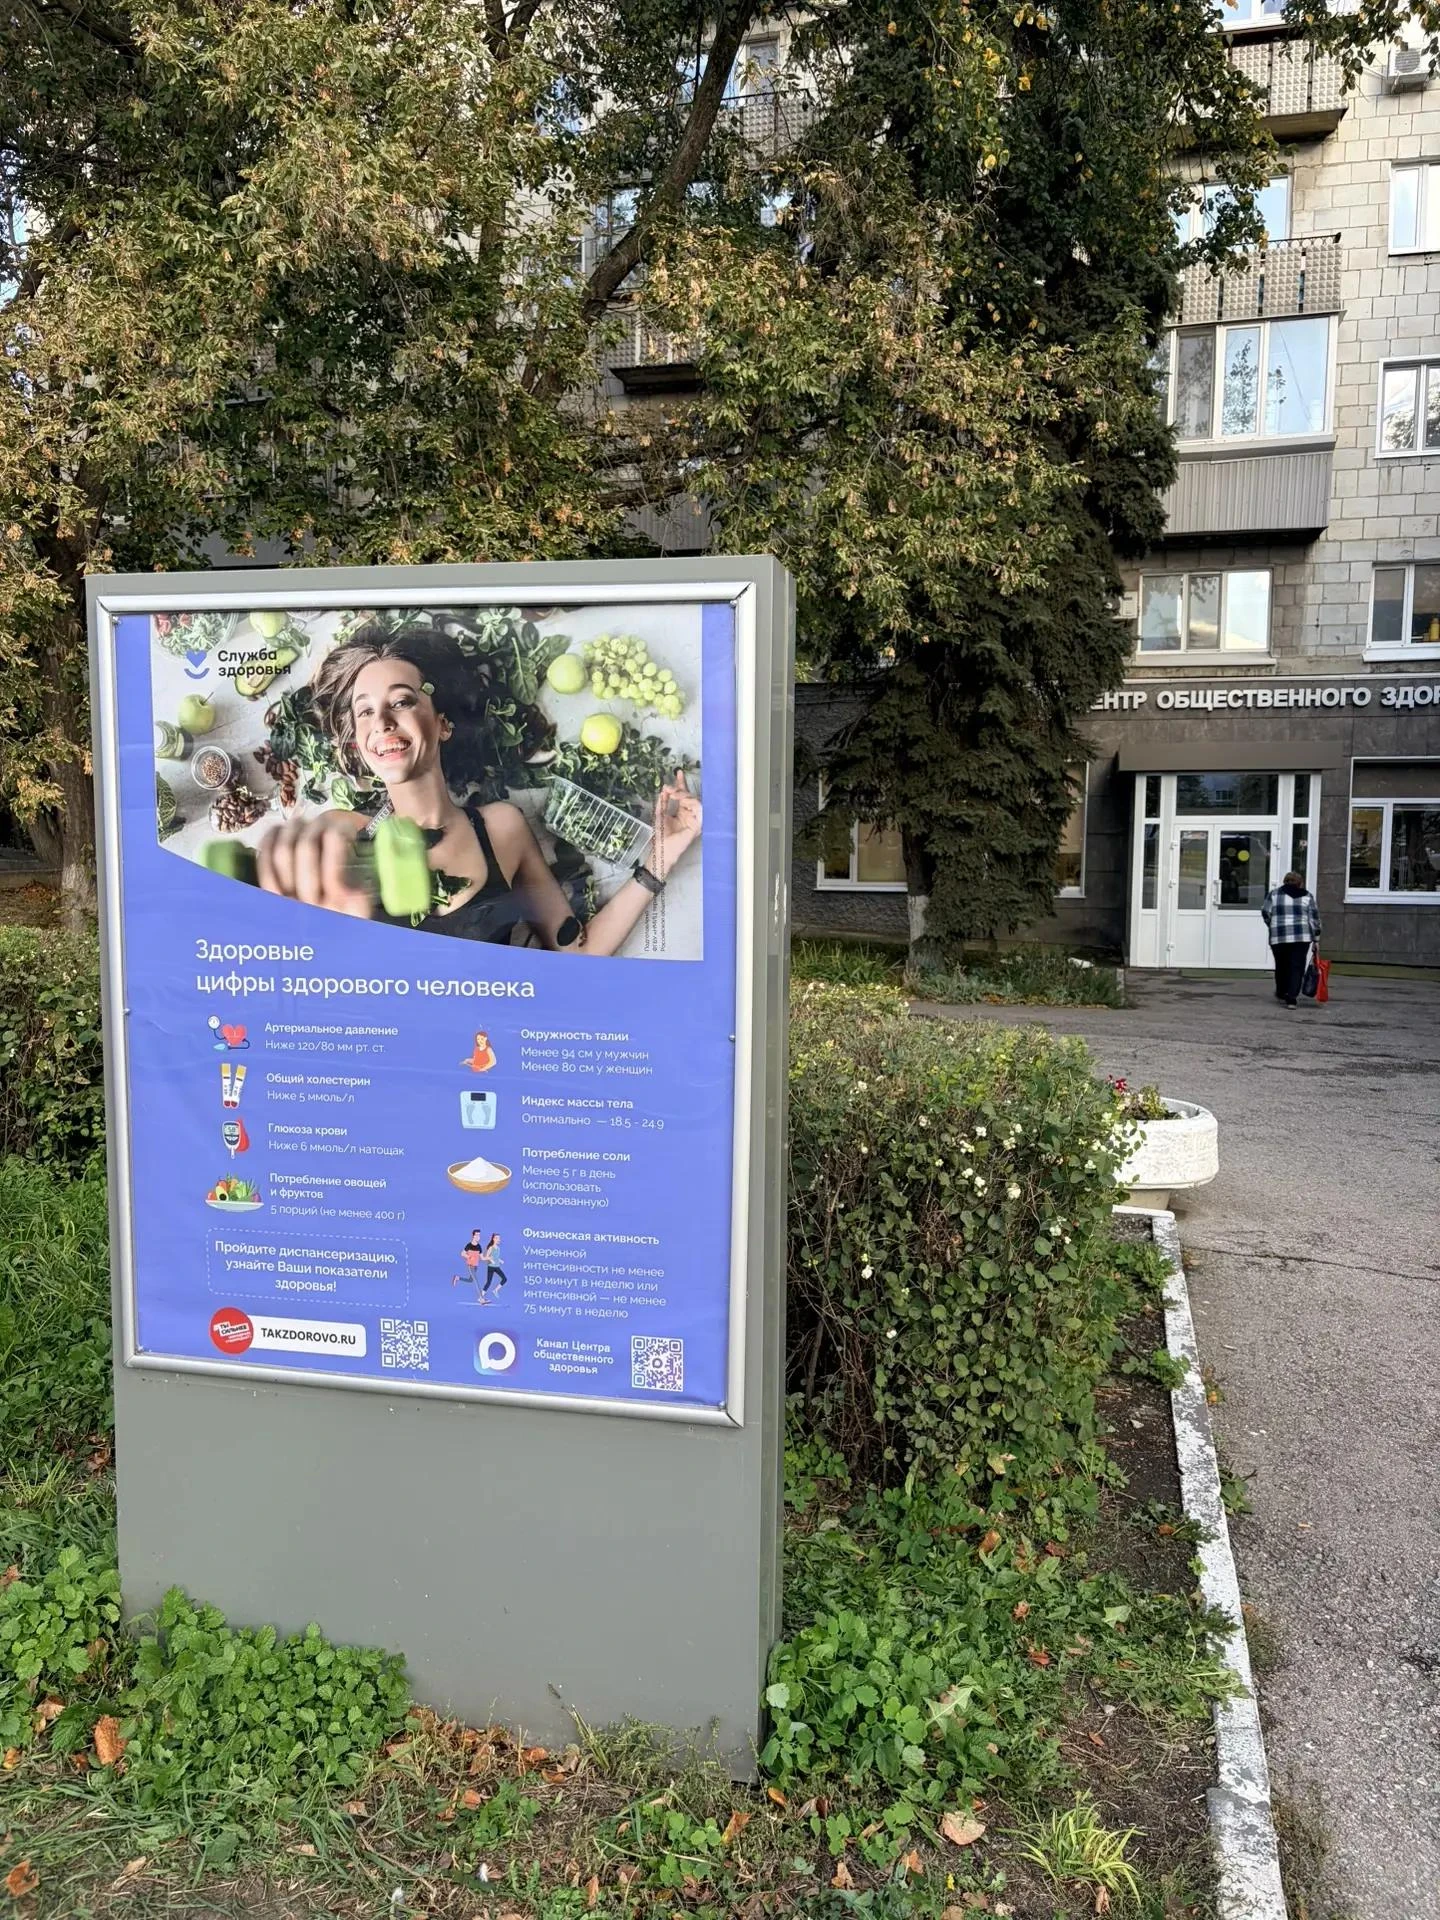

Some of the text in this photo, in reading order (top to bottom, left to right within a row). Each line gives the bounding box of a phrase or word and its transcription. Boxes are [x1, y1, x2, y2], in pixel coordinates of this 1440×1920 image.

[218, 648, 277, 664] Служба
[218, 664, 291, 678] здоровья
[1088, 690, 1147, 710] ЕНТР
[1156, 687, 1372, 711] ОБЩЕСТВЕННОГО
[196, 939, 314, 964] Здоровые
[196, 971, 535, 998] цифры здорового человека
[264, 1022, 398, 1036] Артериальное давление
[520, 1028, 629, 1043] Окружность талии
[265, 1040, 295, 1050] Ниже
[298, 1041, 334, 1051] 120/80
[338, 1044, 352, 1052] мм
[521, 1047, 649, 1062] Менее 94 см у мужчин
[521, 1062, 653, 1076] Менее 80 см у женщин
[266, 1072, 370, 1087] Общий холестерин
[267, 1090, 354, 1103] Ниже 5 ммоль/л
[522, 1096, 634, 1109] Индекс массы тела
[522, 1113, 591, 1126] Оптимально
[268, 1122, 348, 1138] Глюкоза крови
[268, 1140, 405, 1157] Ниже 6 ммоль/л натощак
[522, 1148, 631, 1162] Потребление соли
[522, 1166, 560, 1176] Менее
[562, 1168, 570, 1178] 5
[589, 1170, 616, 1180] день
[270, 1173, 387, 1189] Потребление овощей
[522, 1180, 601, 1193] (использовать
[270, 1188, 324, 1200] и фруктов
[522, 1194, 609, 1209] йодированную)
[270, 1205, 406, 1221] 5 порций (не менее 400 г)
[522, 1228, 660, 1246] Физическая активность
[215, 1241, 398, 1265] Пройдите диспансеризацию,
[523, 1246, 586, 1260] Умеренной
[226, 1259, 388, 1279] узнайте Ваши показатели
[523, 1261, 664, 1278] интенсивности не менее
[274, 1279, 336, 1293] здоровья!
[524, 1276, 658, 1292] 150 минут в неделю или
[524, 1289, 597, 1302] интенсивной
[613, 1295, 628, 1304] не
[630, 1296, 666, 1306] менее
[524, 1304, 628, 1319] 75 минут в неделю
[261, 1327, 356, 1345] TAKZDOROVO.RU
[536, 1337, 610, 1354] Канал Центра
[533, 1350, 614, 1365] общественного
[549, 1362, 598, 1375] здоровья
